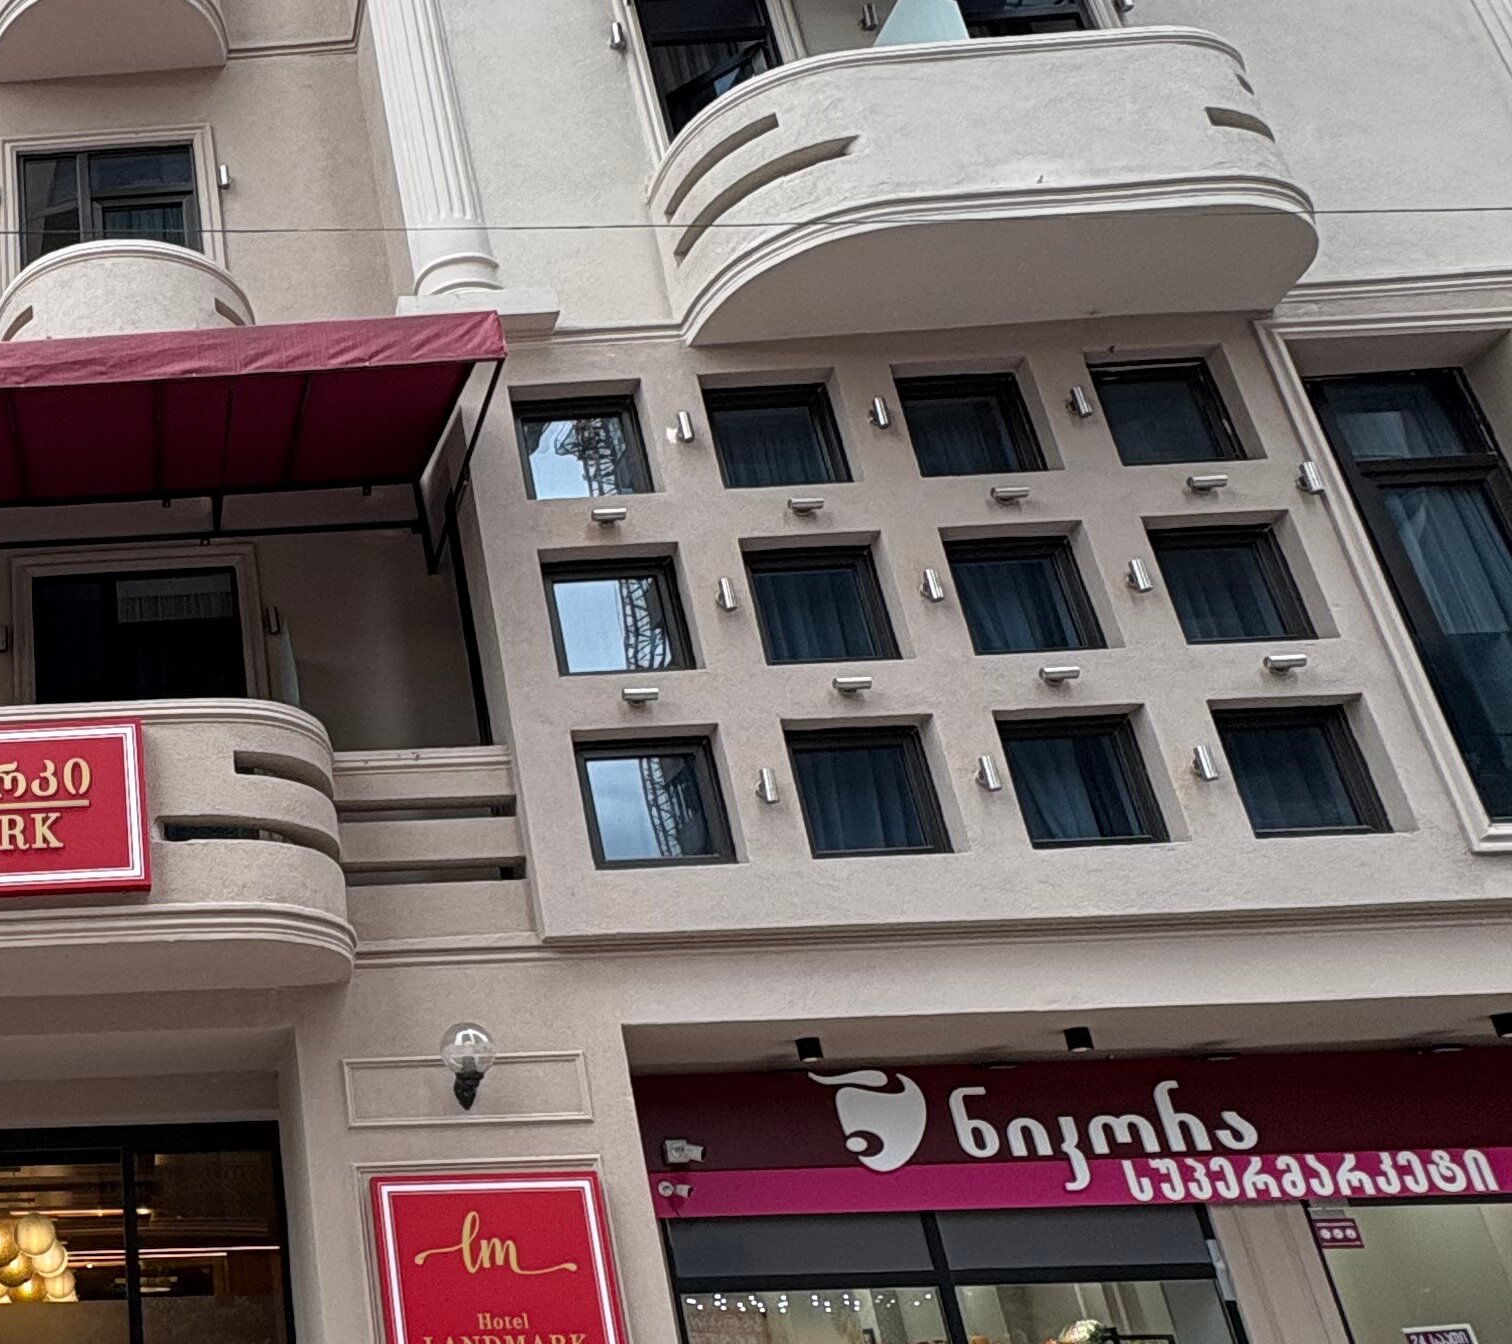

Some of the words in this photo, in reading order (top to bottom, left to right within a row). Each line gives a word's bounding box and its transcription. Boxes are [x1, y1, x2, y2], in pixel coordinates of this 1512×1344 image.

[948, 1080, 1259, 1191] ნიკორა
[1121, 1148, 1500, 1203] სუპერმარკეტი
[476, 1312, 530, 1330] Hotel
